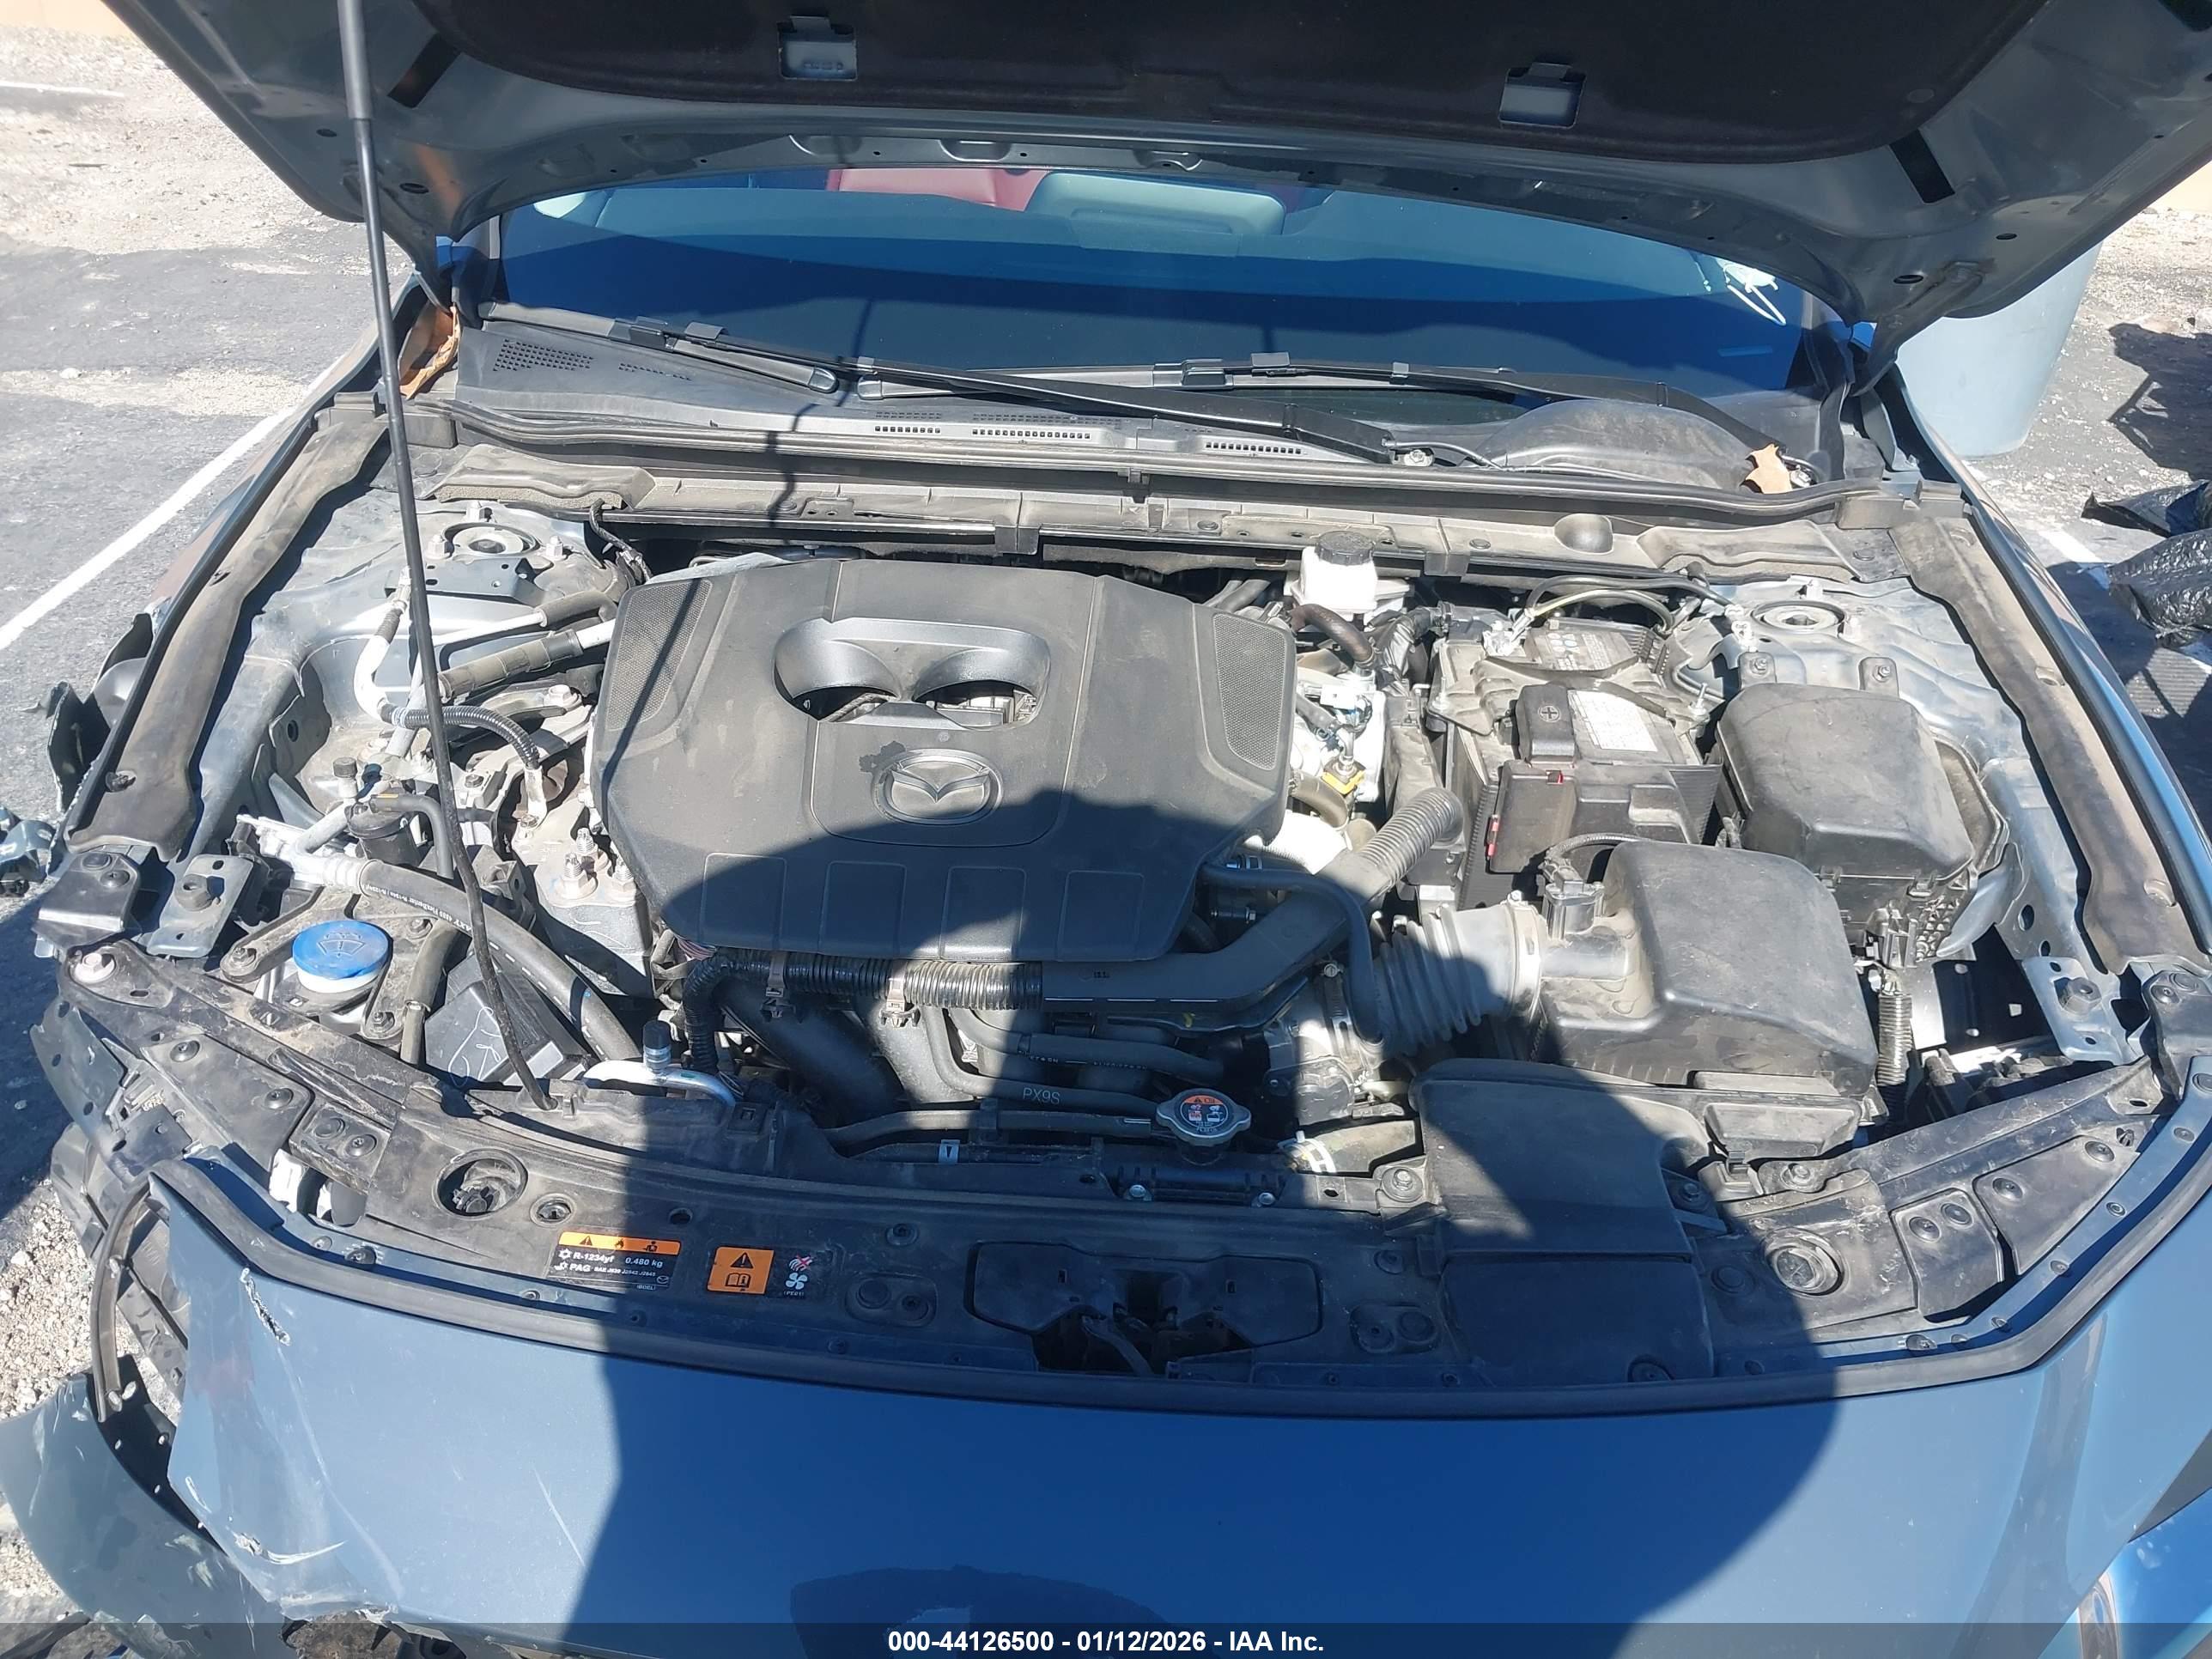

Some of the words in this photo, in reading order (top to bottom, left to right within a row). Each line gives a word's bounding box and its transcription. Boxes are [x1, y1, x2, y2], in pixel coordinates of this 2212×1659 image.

[1023, 1087, 1060, 1104] PX9S
[569, 1263, 592, 1272] PAG
[573, 1251, 615, 1263] R-1234yf
[625, 1257, 650, 1266] 0.480
[651, 1258, 663, 1268] kg
